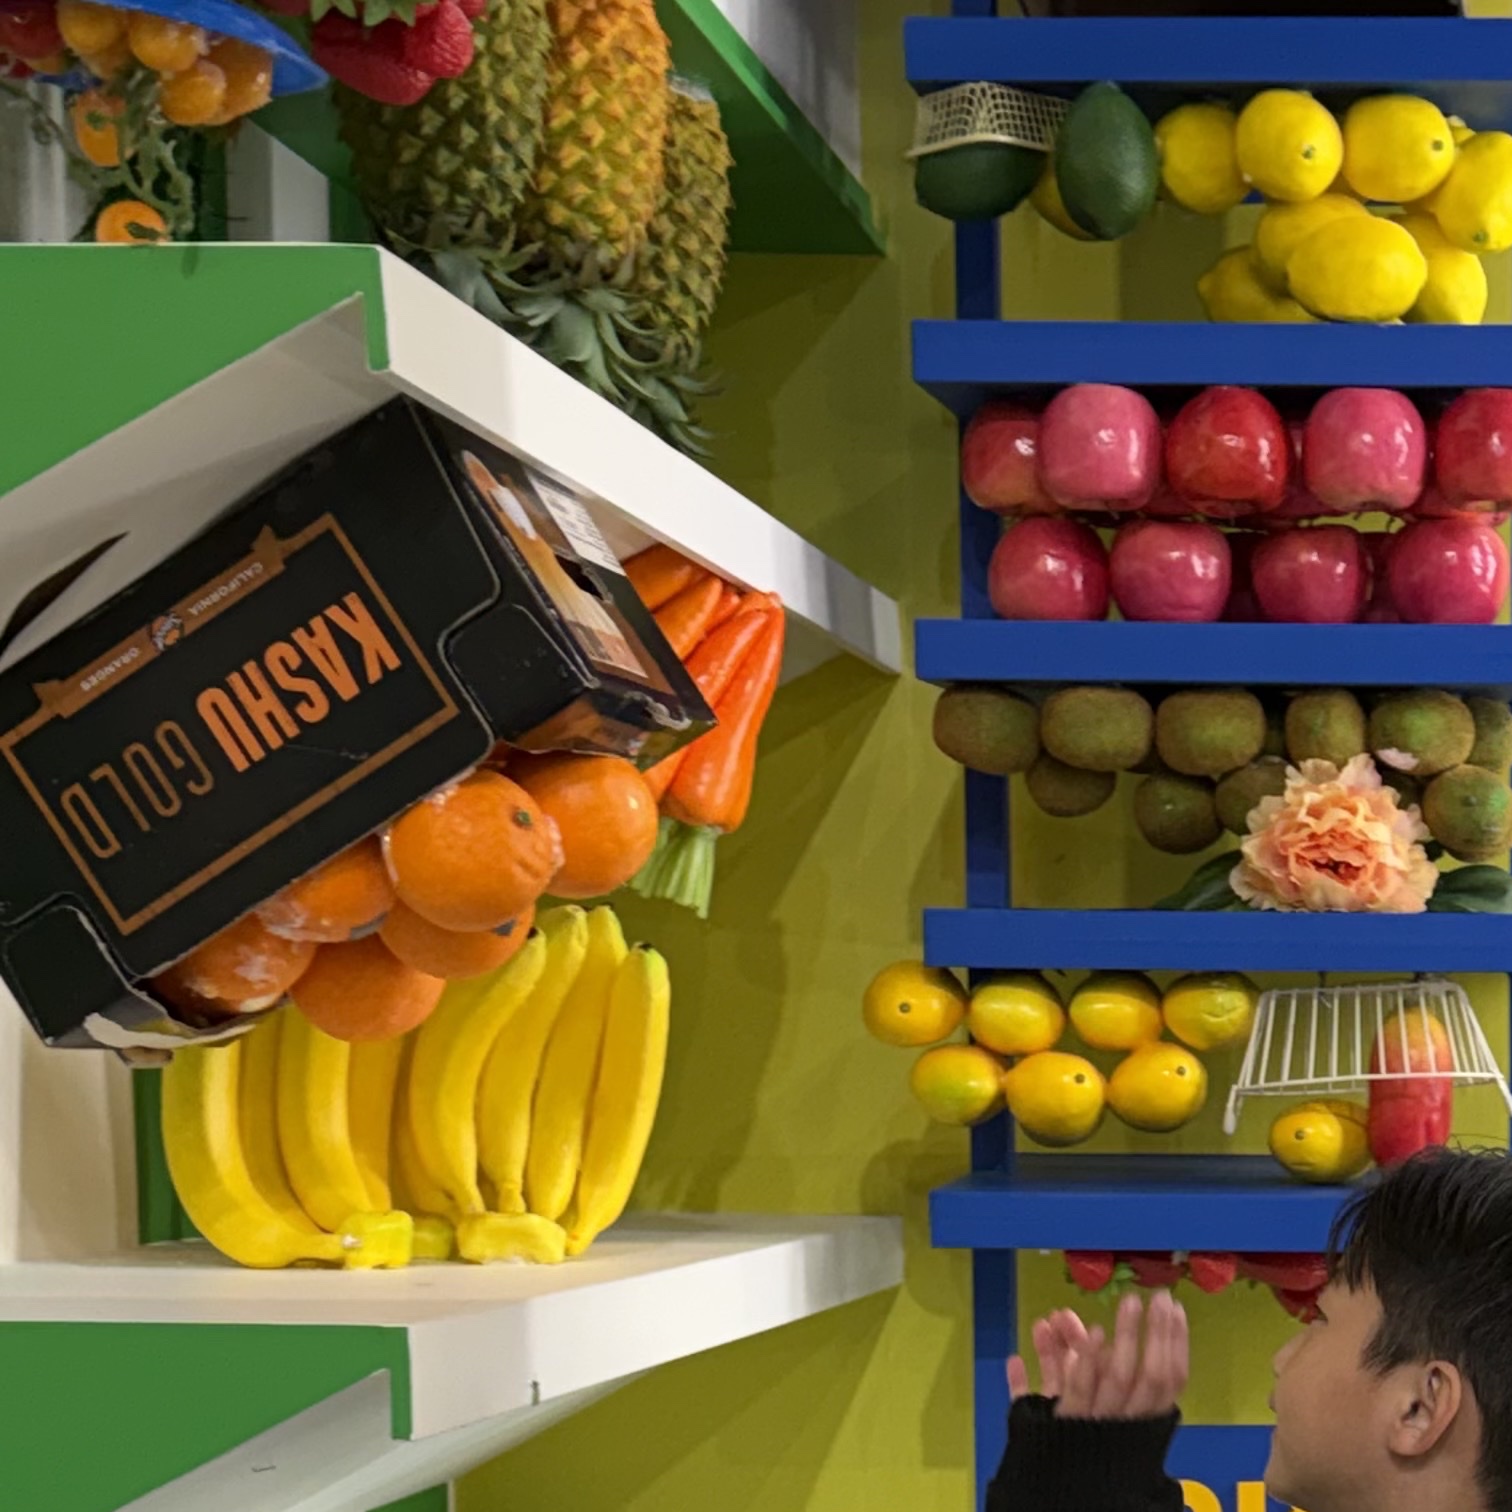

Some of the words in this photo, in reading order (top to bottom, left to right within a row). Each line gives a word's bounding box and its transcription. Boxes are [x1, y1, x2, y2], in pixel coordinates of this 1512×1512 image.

[187, 561, 265, 617] CALIFORNIA
[79, 645, 142, 694] ORANGES
[197, 590, 403, 773] KASHU
[58, 721, 214, 860] GOLD
